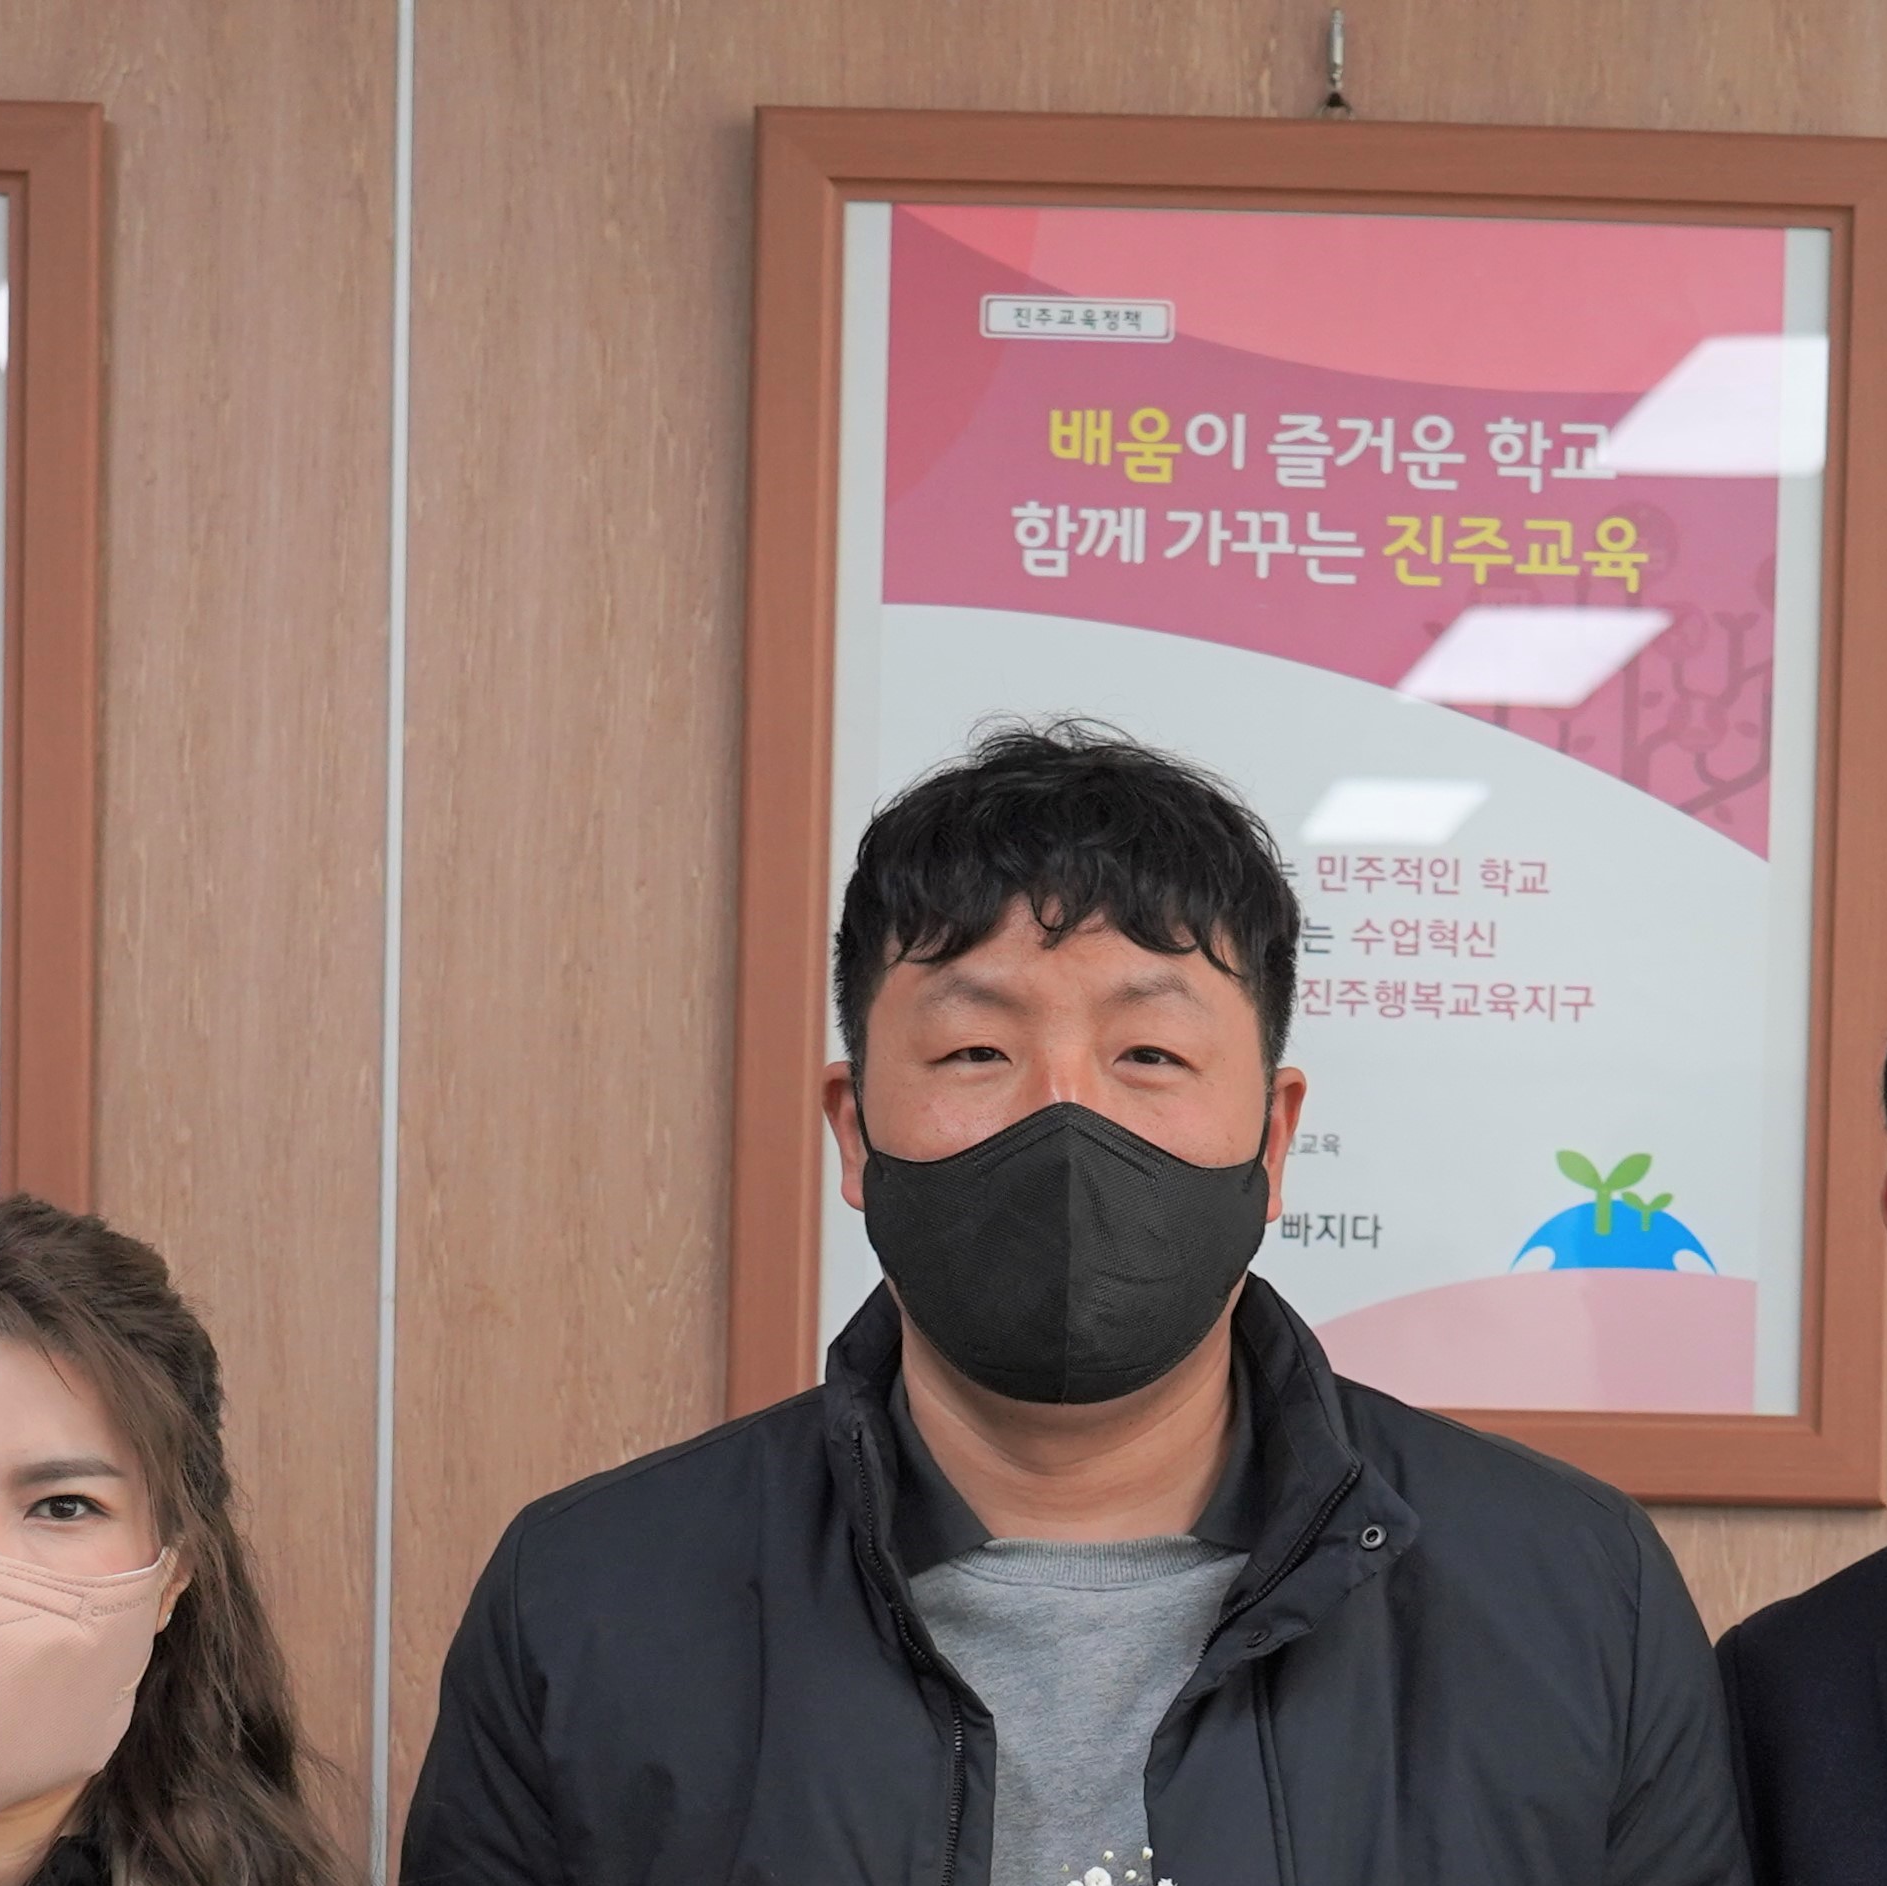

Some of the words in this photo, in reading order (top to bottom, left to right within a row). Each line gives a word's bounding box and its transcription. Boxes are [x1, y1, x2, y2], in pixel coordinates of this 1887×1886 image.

[1011, 306, 1144, 332] 진주교육정책
[1050, 407, 1245, 483] 배움이
[1268, 415, 1466, 490] 즐거운
[1486, 418, 1616, 492] 학교
[1012, 501, 1146, 577] 함께
[1164, 510, 1365, 584] 가꾸는
[1383, 515, 1649, 592] 진주교육
[1317, 855, 1459, 895] 민주적인
[1480, 858, 1550, 897] 학교
[1351, 918, 1495, 958] 수업혁신
[1300, 979, 1594, 1022] 진주행복교육지구
[1280, 1213, 1382, 1248] 빠지다
